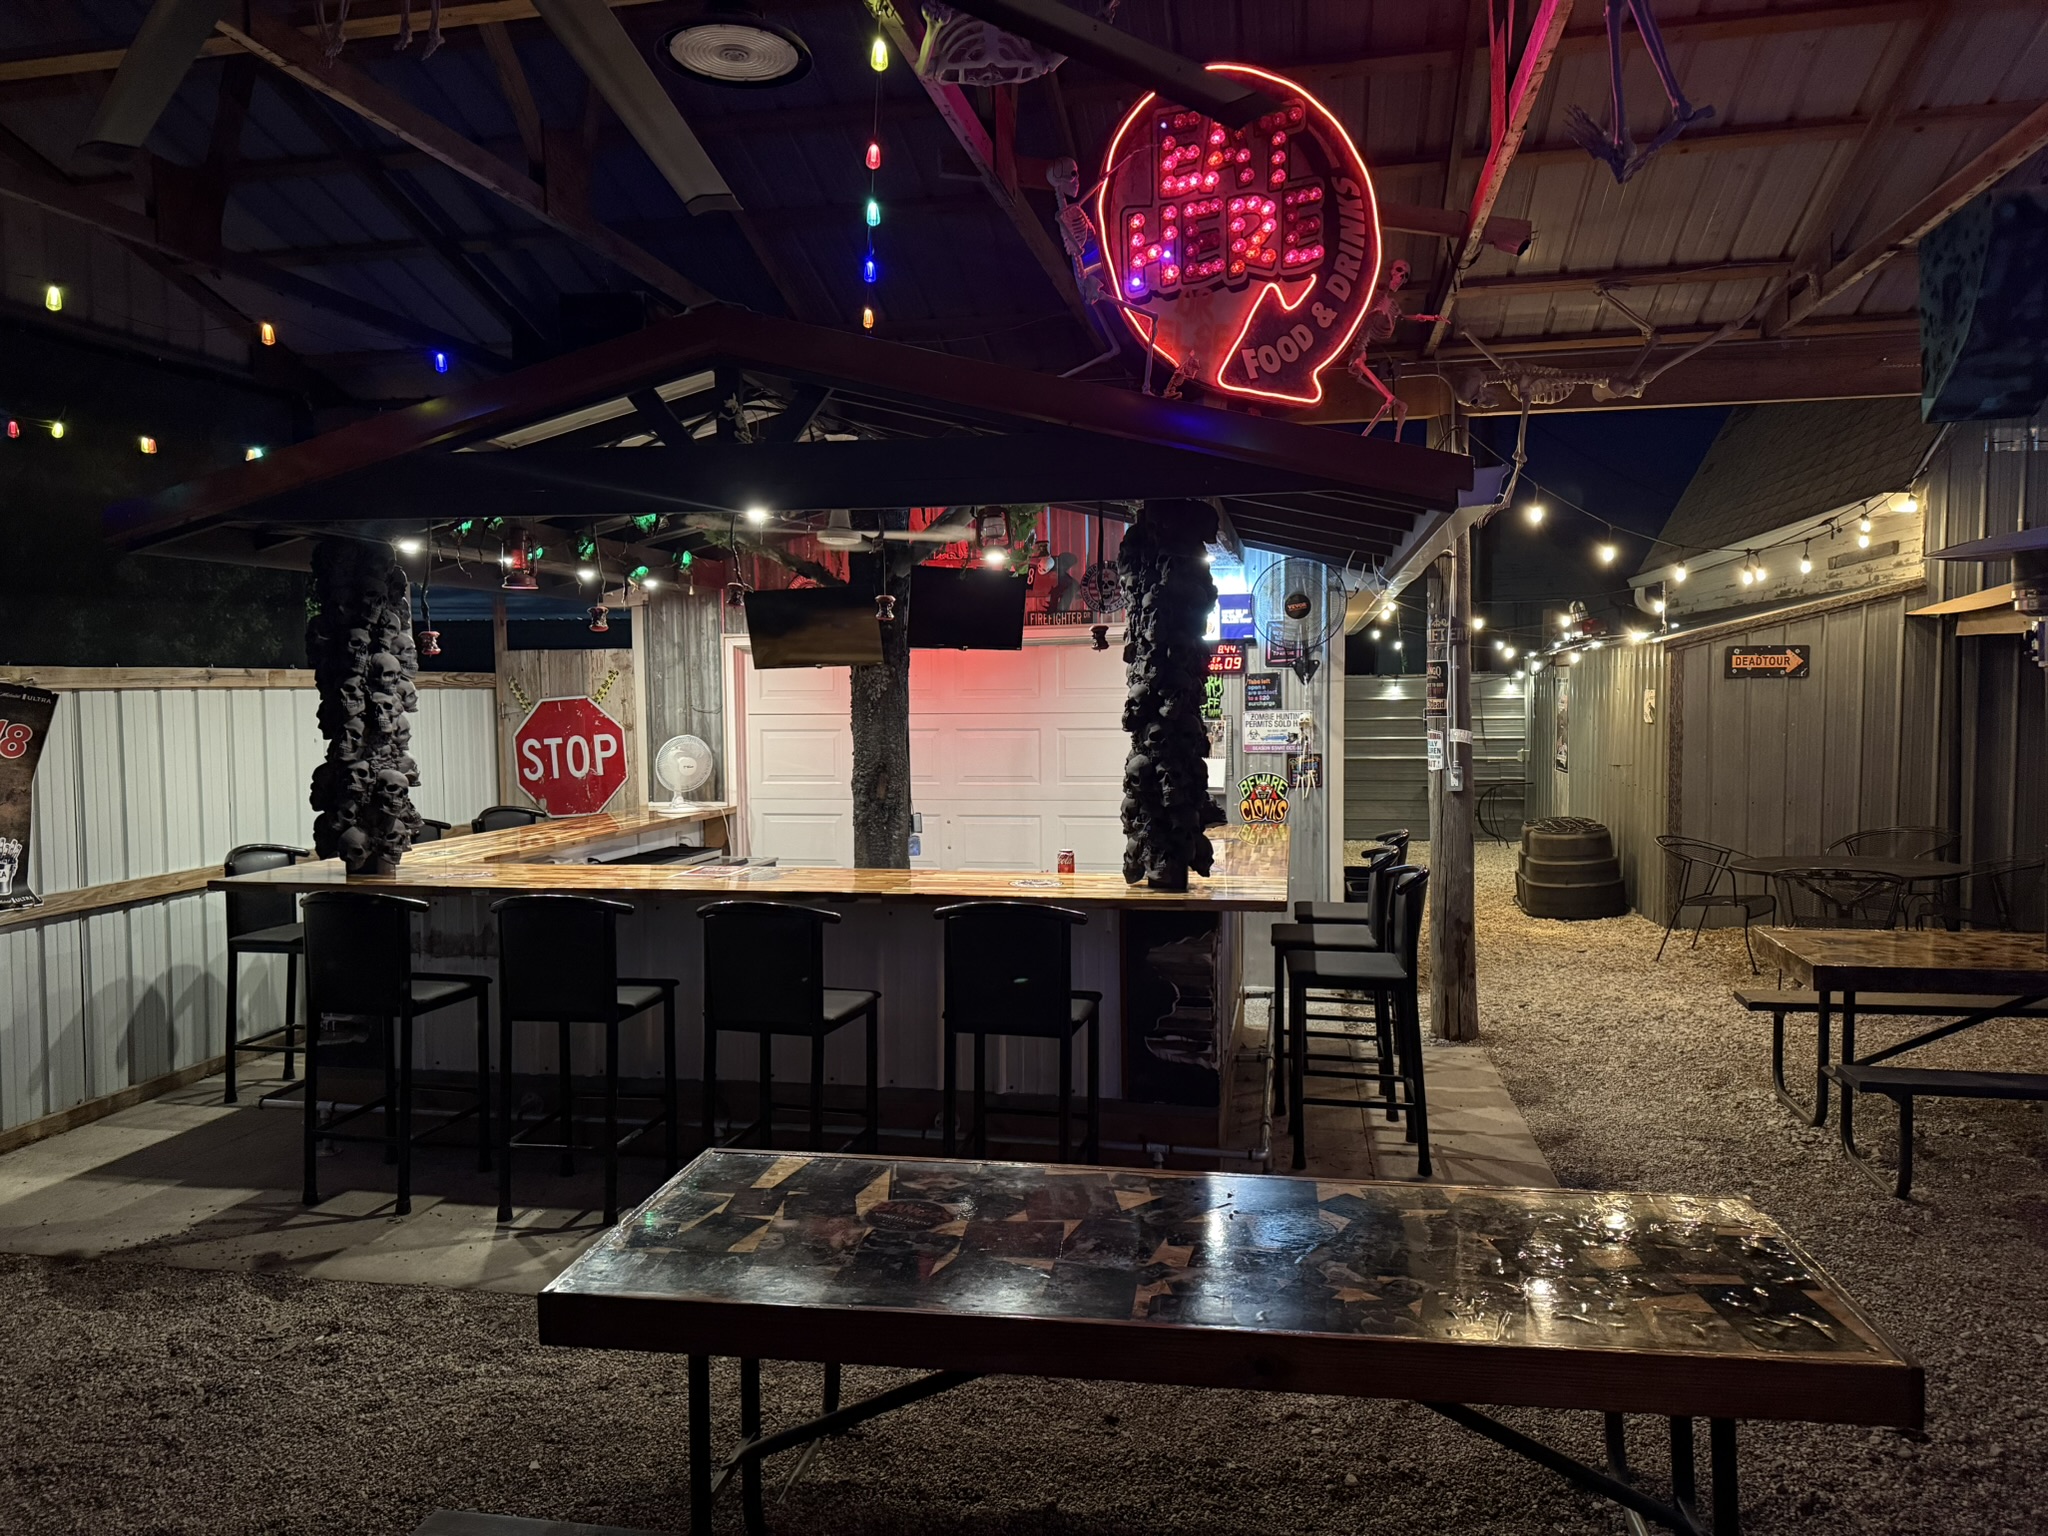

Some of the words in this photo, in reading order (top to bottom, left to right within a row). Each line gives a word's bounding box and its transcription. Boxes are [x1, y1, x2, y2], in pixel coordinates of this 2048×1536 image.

[1155, 101, 1304, 199] EAT
[1124, 182, 1325, 297] HERE
[1242, 324, 1314, 379] FOOD
[1312, 302, 1337, 328] &
[1325, 176, 1365, 301] DRINKS
[1030, 612, 1082, 625] FIREFIGHTER
[1224, 657, 1242, 669] 09
[1735, 656, 1790, 666] DEADTOUR
[1276, 712, 1302, 720] HUNTIN
[522, 734, 617, 781] STOP
[1240, 774, 1288, 798] BEWARE
[1240, 799, 1288, 821] CLOWNS
